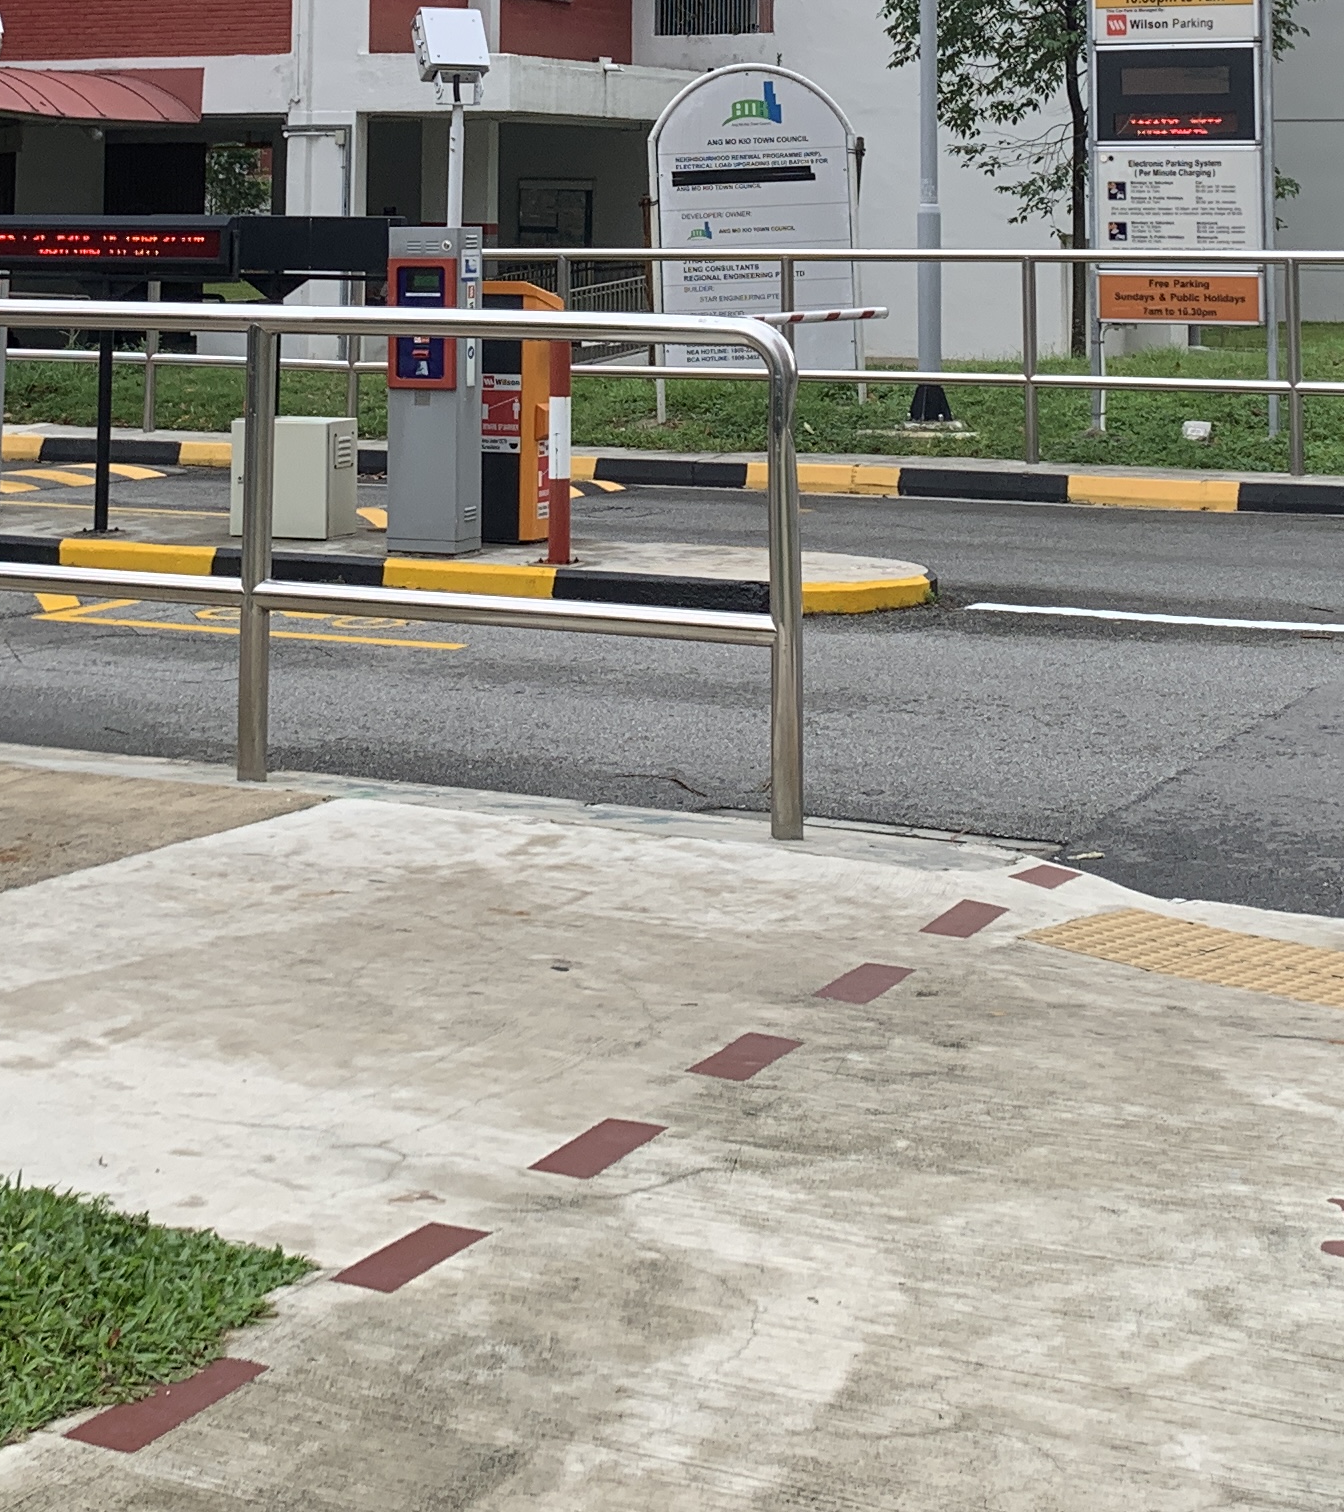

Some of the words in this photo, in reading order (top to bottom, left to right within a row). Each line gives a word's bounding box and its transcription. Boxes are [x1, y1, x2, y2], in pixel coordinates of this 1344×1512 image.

[1130, 19, 1168, 29] Wilson
[1172, 18, 1213, 30] Parking
[1128, 159, 1164, 167] Electronic
[1165, 159, 1193, 168] Parking
[1195, 159, 1222, 168] System
[705, 264, 759, 272] CONSULTANTS
[683, 274, 721, 282] REGIONAL
[724, 271, 773, 280] ENGINEERING
[684, 285, 714, 293] BUILDER:
[1149, 279, 1169, 288] Free
[1174, 279, 1210, 289] Parking
[719, 294, 765, 302] ENGINEERING
[1114, 292, 1155, 303] Sundays
[1159, 293, 1166, 301] &
[1170, 293, 1199, 302] Public
[1204, 294, 1245, 304] Holidays
[1143, 307, 1162, 316] 7am
[1165, 307, 1175, 316] to
[1177, 308, 1217, 317] 10.30pm
